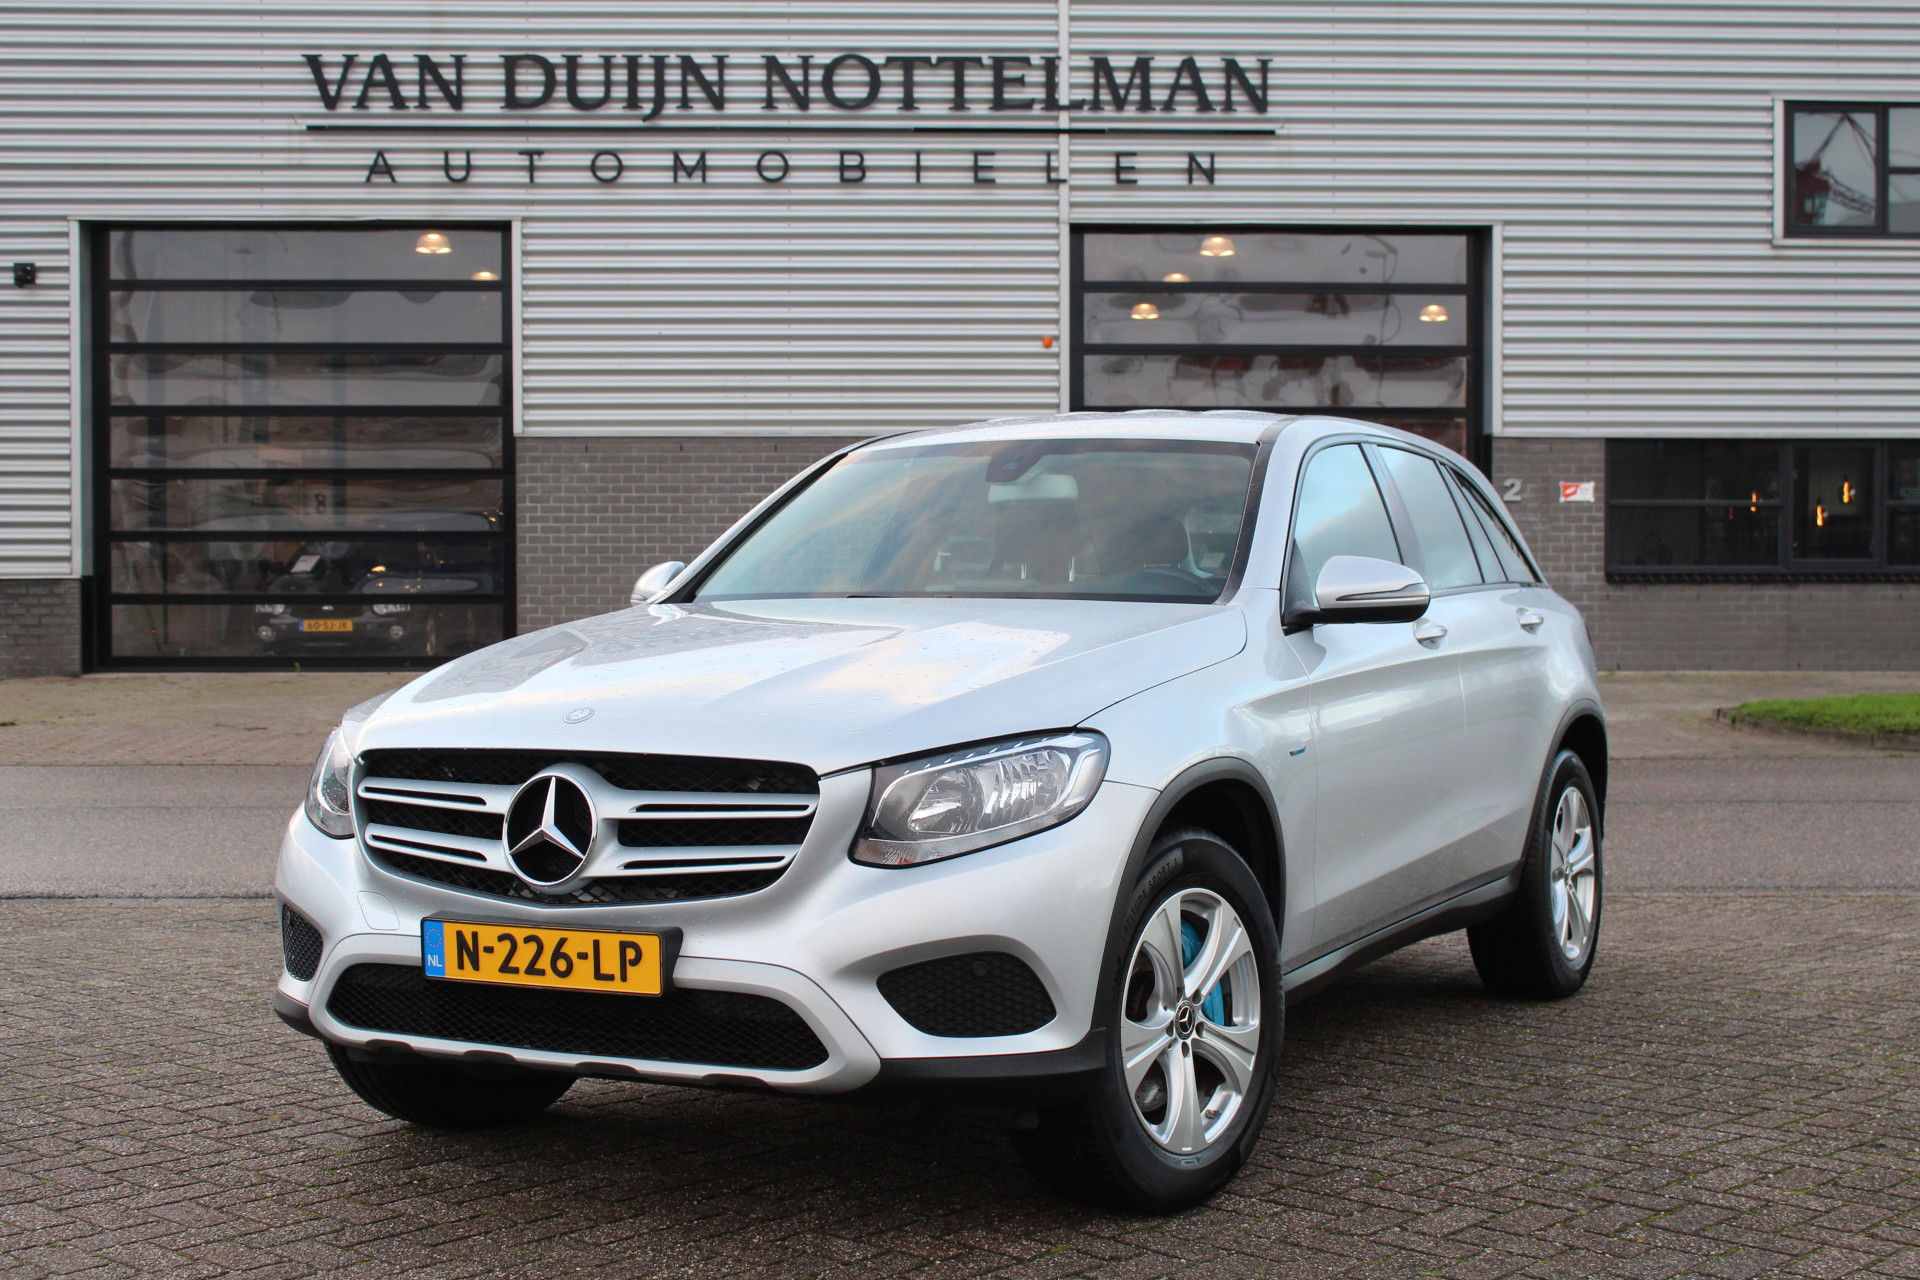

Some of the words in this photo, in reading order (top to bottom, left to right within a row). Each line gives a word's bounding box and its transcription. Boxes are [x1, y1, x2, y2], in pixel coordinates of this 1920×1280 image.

[302, 54, 466, 110] VAN
[499, 54, 729, 123] DUIJN
[761, 54, 1271, 112] NOTTELMAN
[365, 149, 1216, 184] AUTOMOBIELEN
[1503, 479, 1521, 501] 2
[427, 953, 443, 967] NL
[456, 930, 642, 982] N-226-LP
